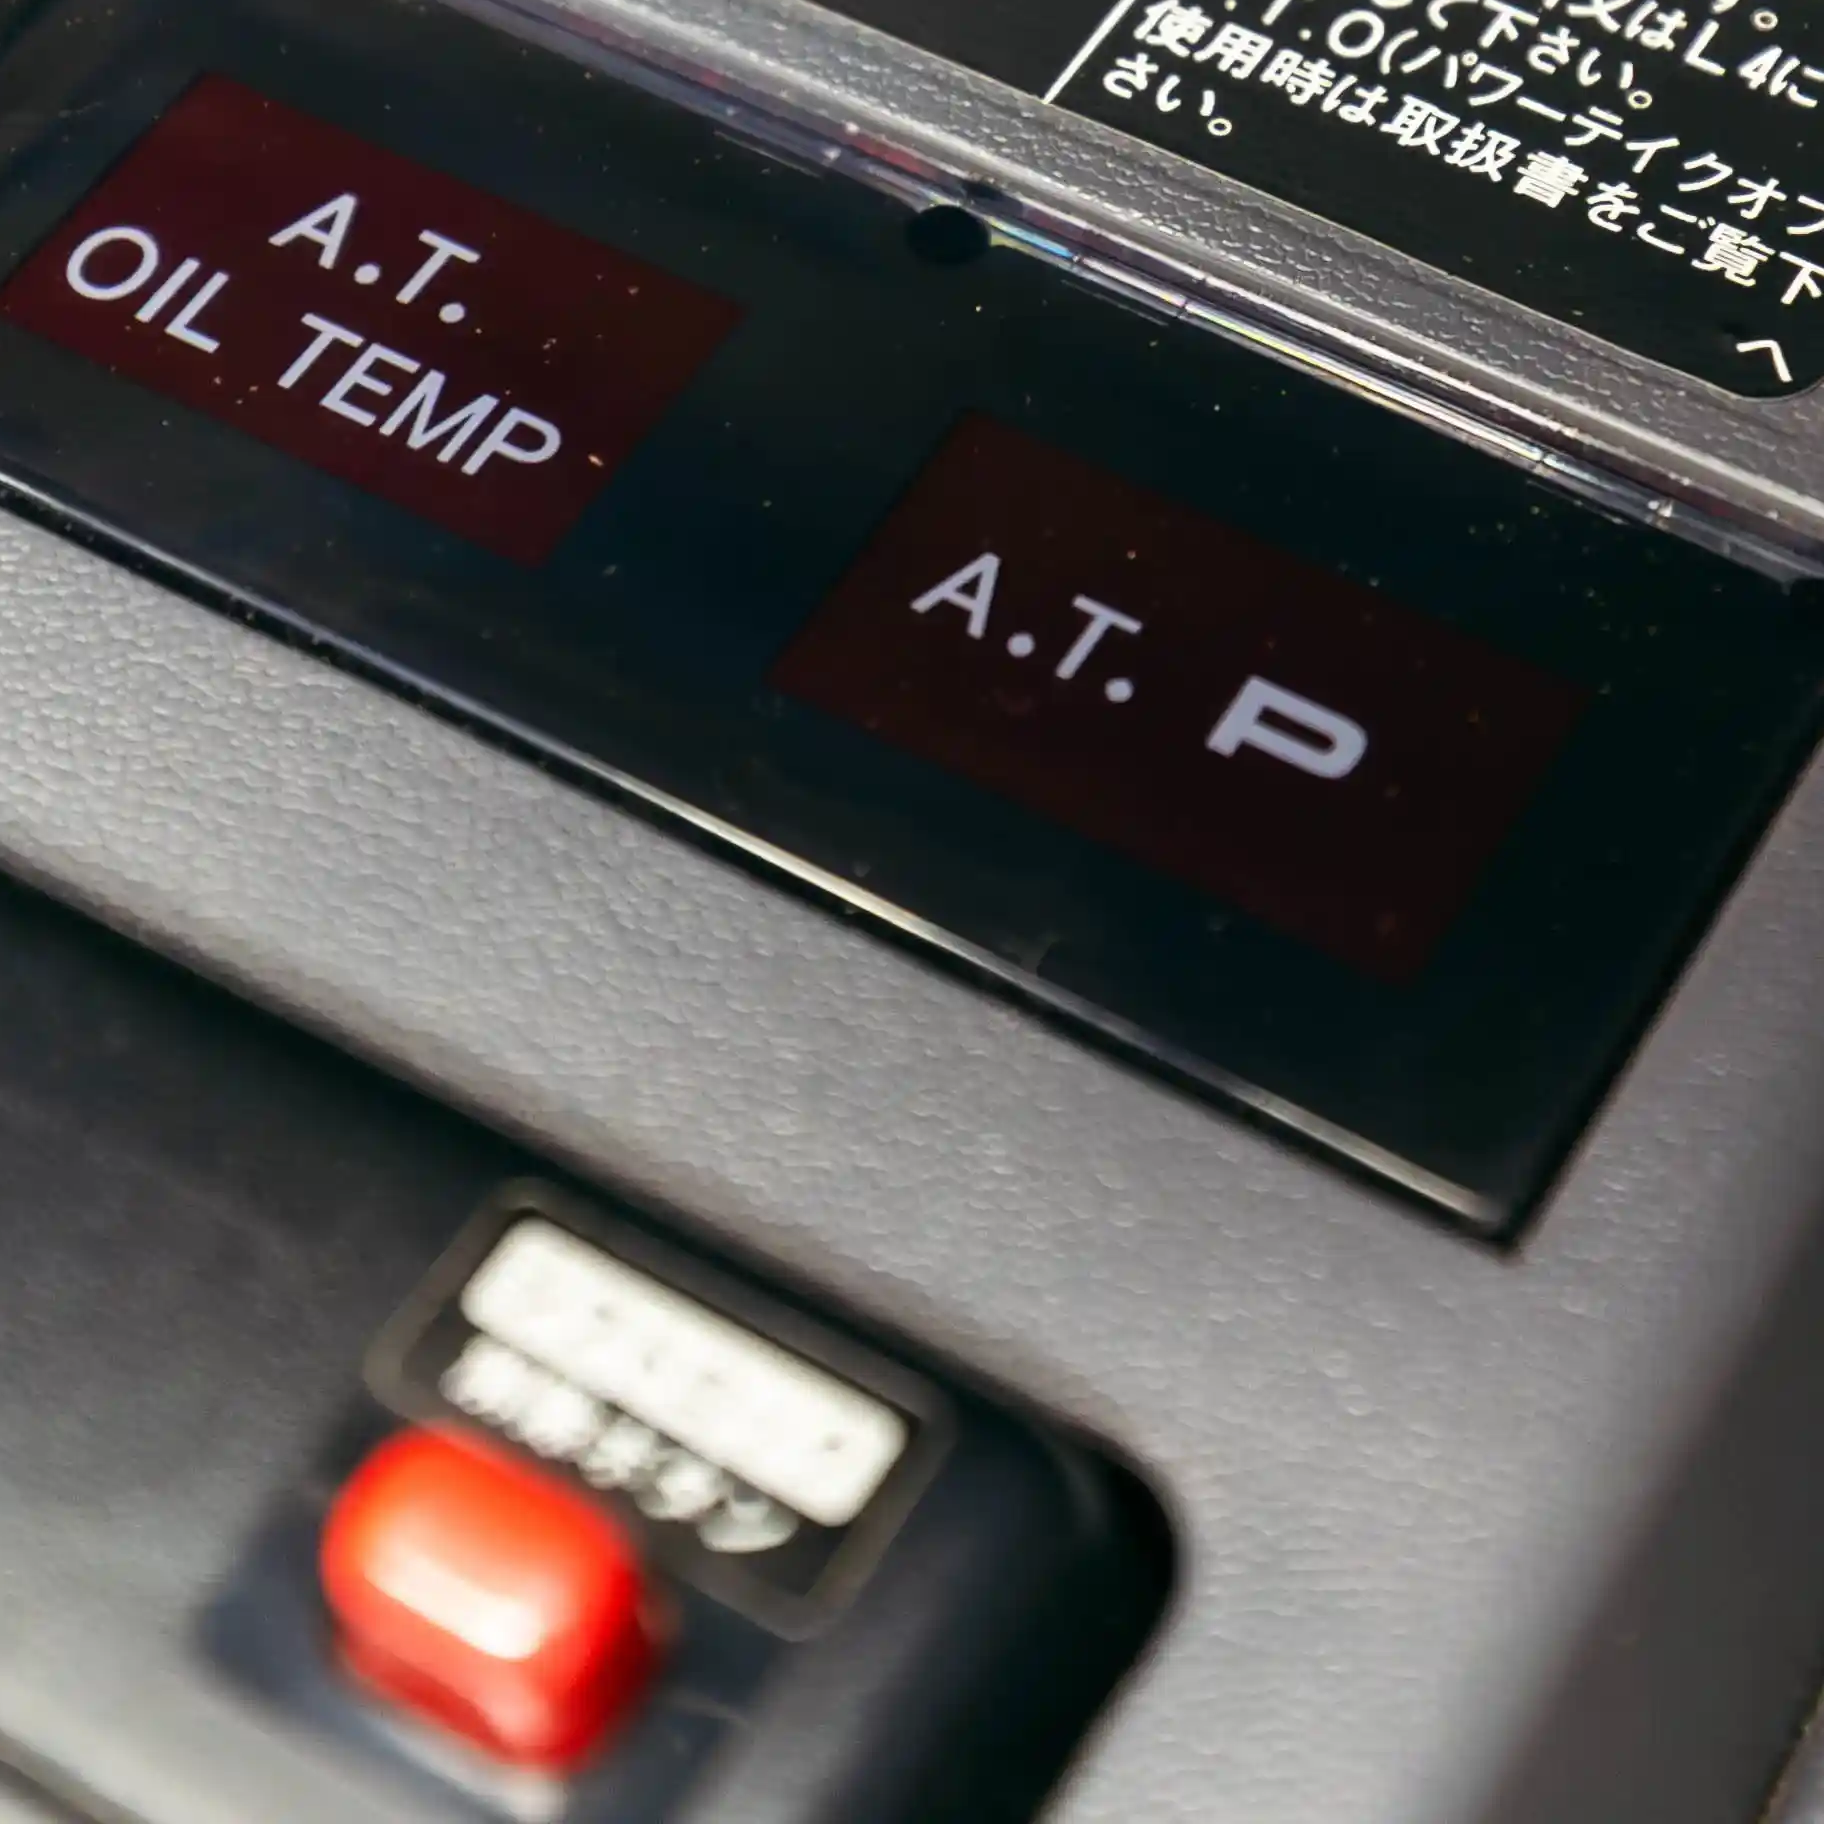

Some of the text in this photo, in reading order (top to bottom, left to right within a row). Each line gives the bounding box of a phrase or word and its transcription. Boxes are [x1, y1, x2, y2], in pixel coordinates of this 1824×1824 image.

[1104, 53, 1232, 136] さい。
[269, 194, 480, 325] A.T.
[66, 226, 560, 475] OIL TEMP
[913, 554, 1365, 777] A.T. P
